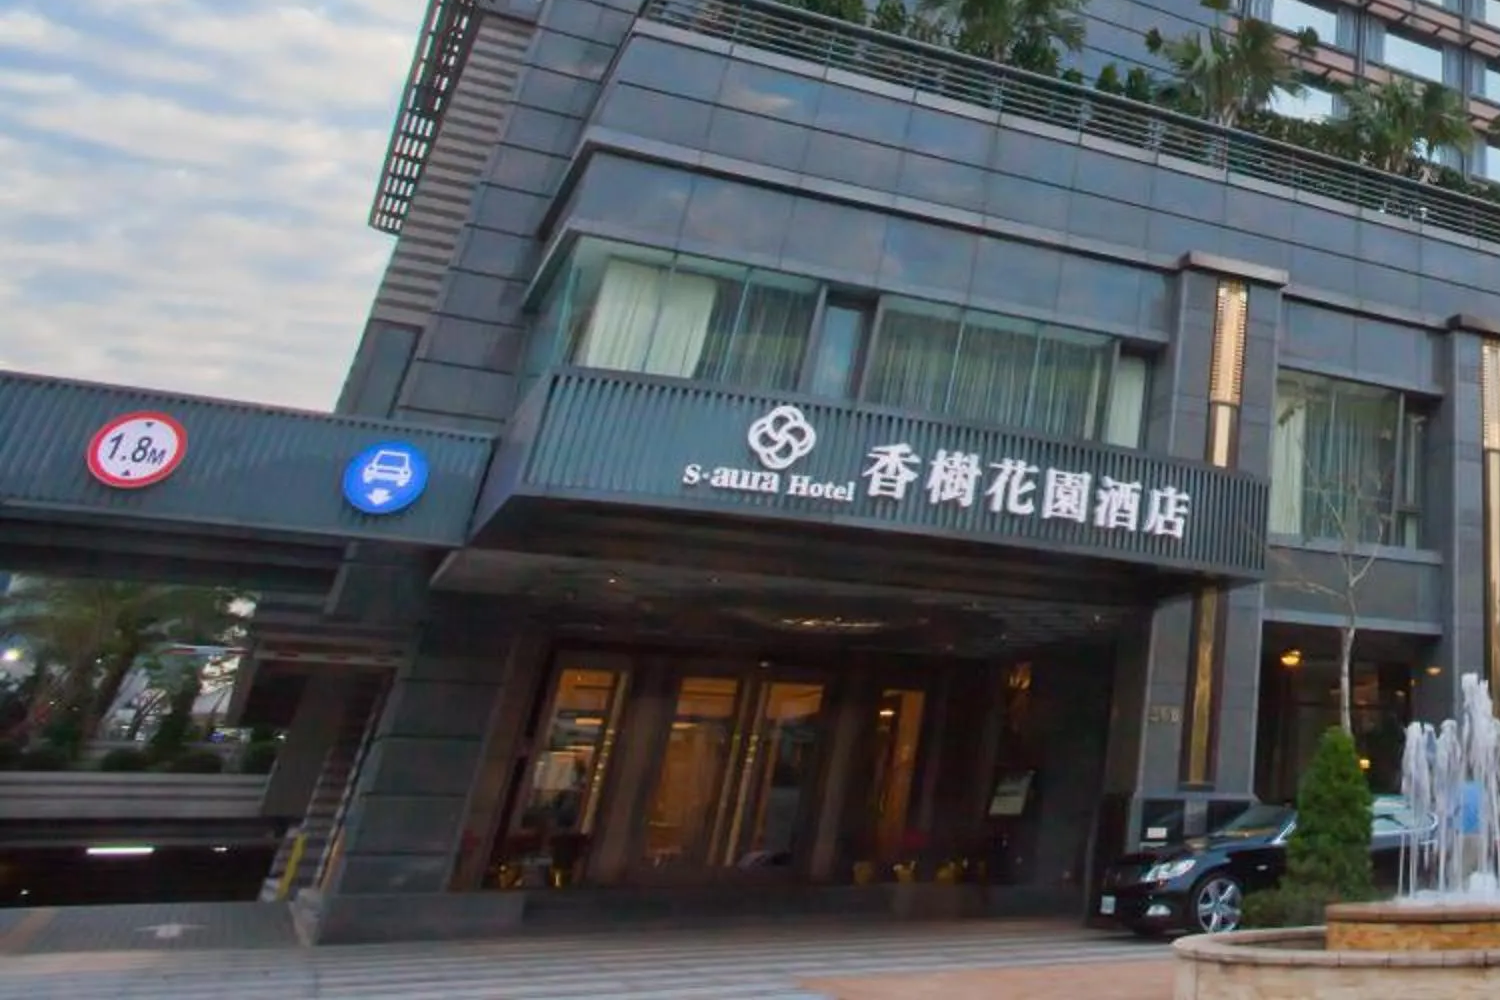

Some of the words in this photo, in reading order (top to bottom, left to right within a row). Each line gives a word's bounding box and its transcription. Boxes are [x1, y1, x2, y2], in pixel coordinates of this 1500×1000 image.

[787, 474, 856, 501] Hotel
[861, 441, 1190, 539] 香樹花園酒店
